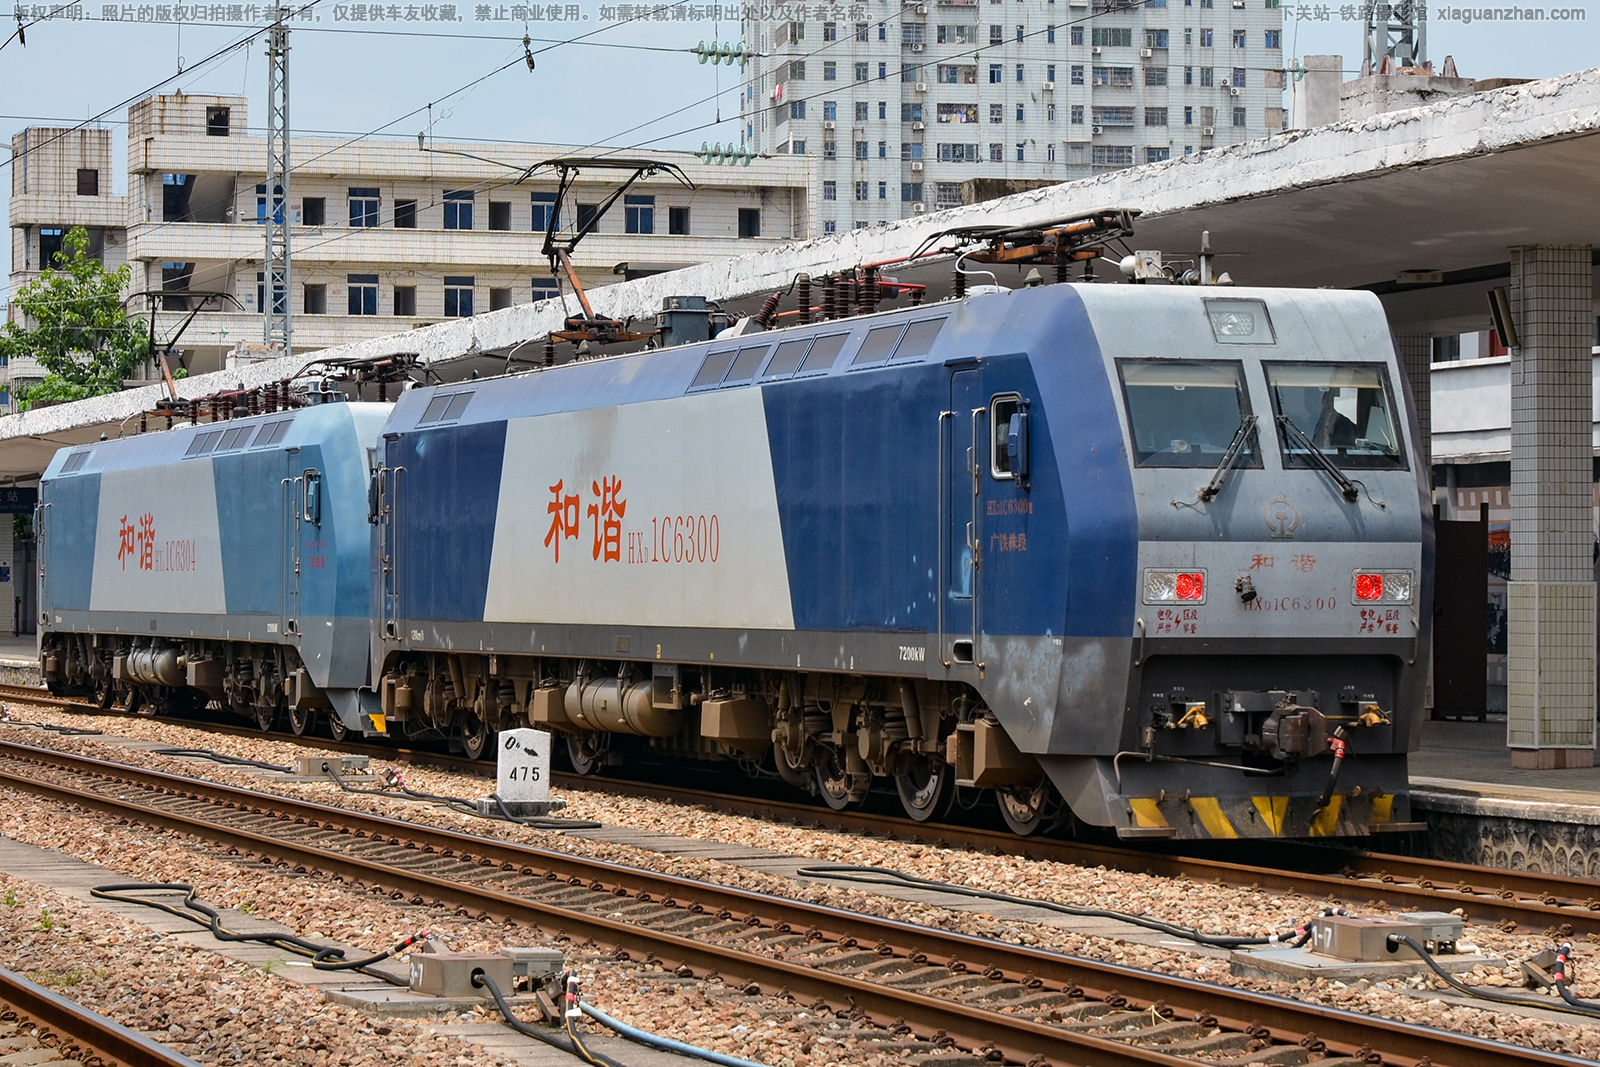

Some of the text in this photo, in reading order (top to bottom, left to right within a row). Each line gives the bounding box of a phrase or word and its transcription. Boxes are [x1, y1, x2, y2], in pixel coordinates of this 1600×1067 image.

[544, 474, 627, 564] 和谐
[118, 512, 156, 571] 和谐
[1249, 553, 1317, 573] 和谐
[898, 645, 926, 662] 7200kW
[509, 766, 540, 782] 475
[1312, 925, 1332, 948] 1-7
